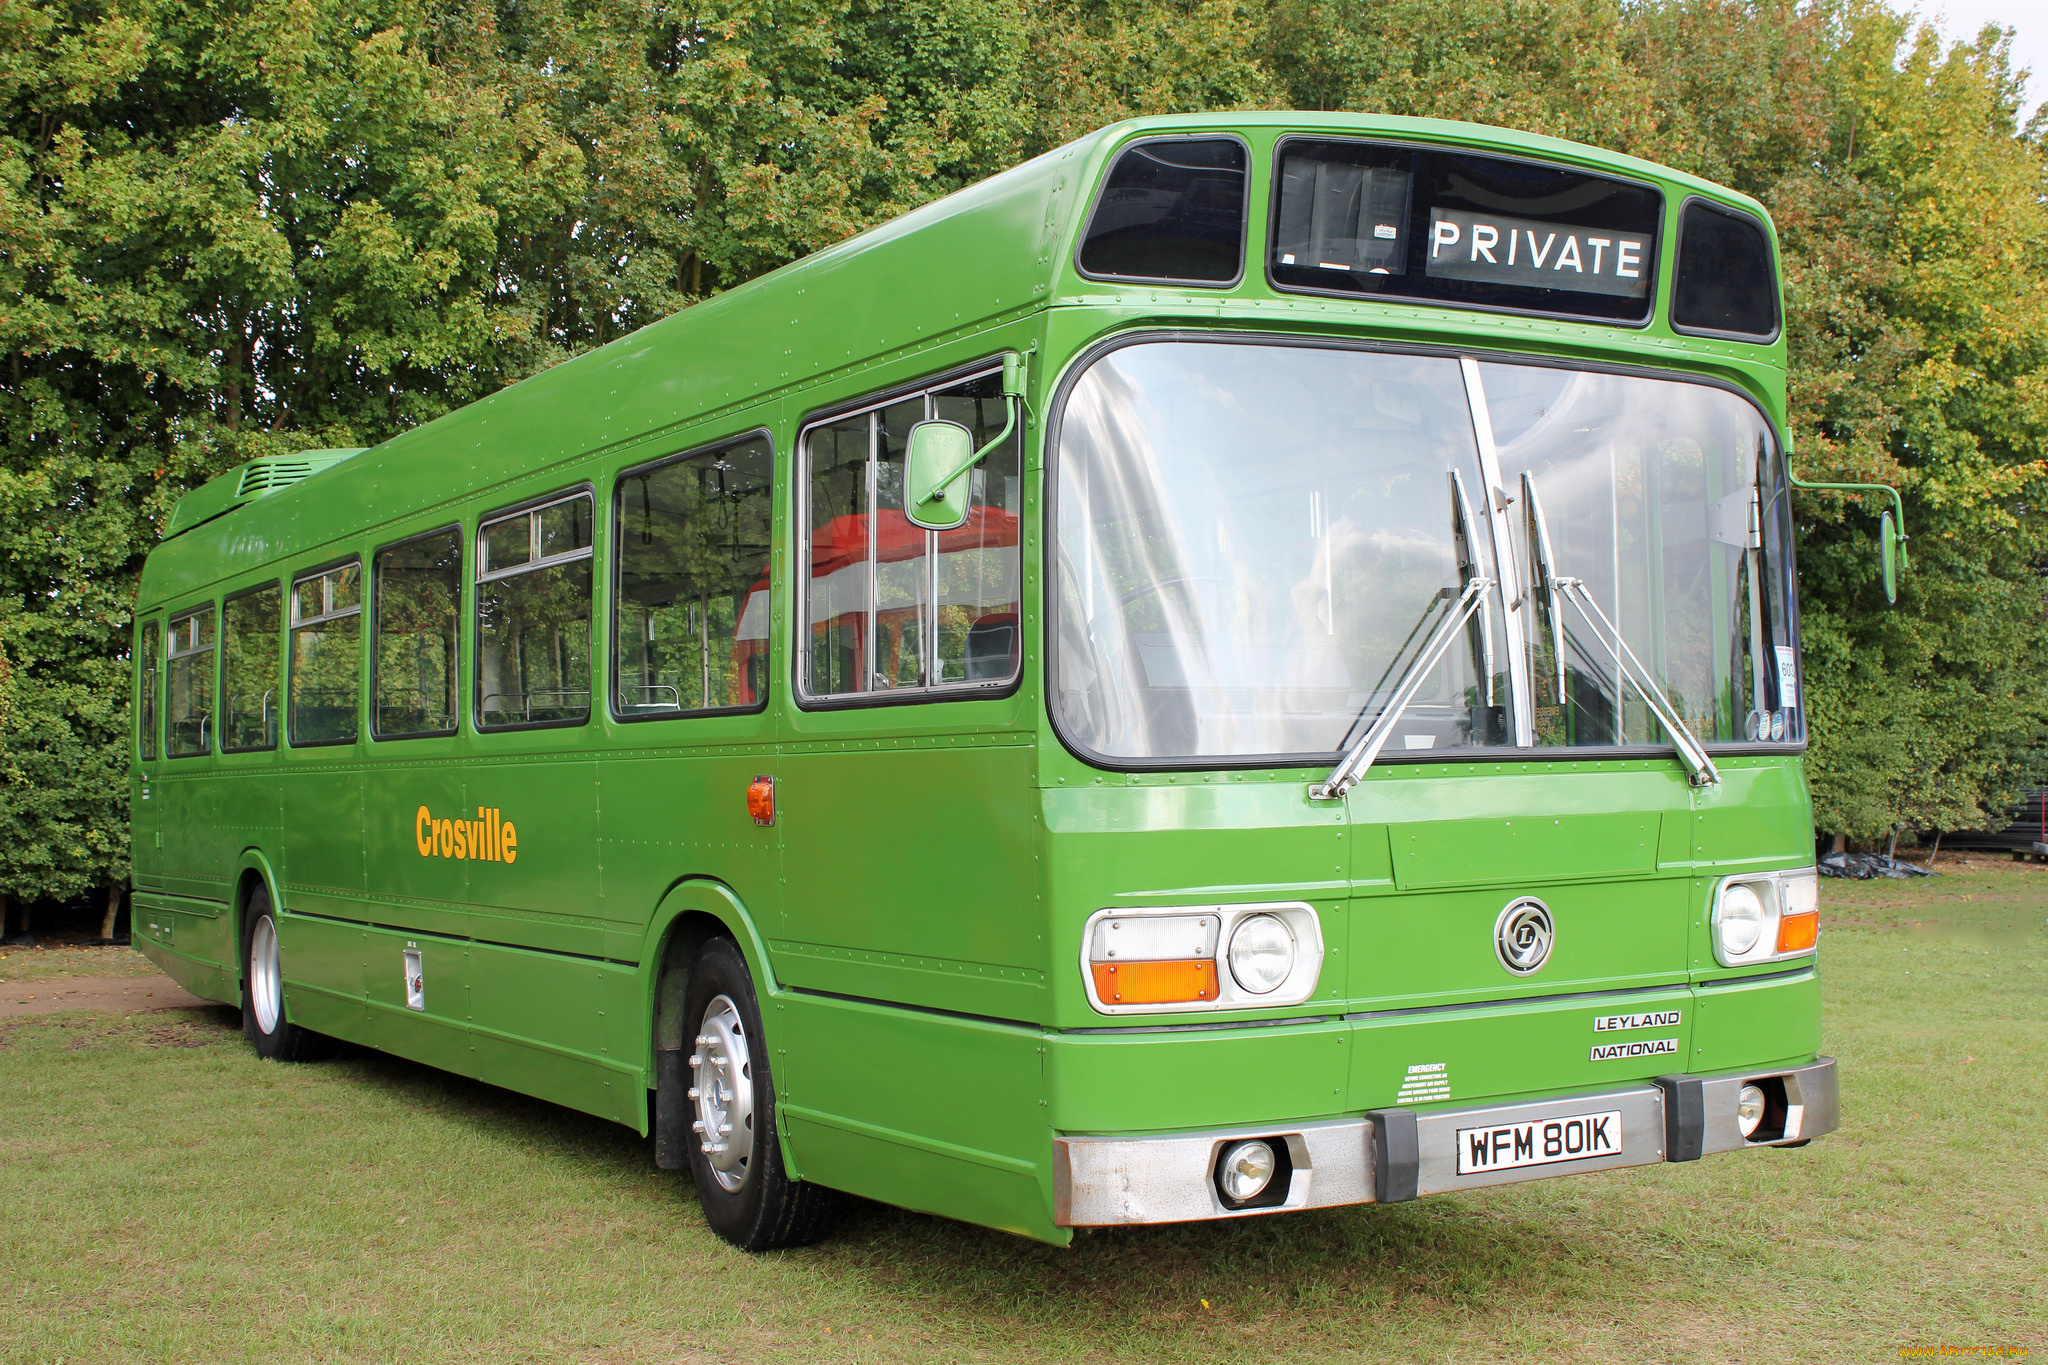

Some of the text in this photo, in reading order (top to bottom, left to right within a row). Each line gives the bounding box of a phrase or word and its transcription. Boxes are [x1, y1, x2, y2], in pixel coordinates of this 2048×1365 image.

[1432, 220, 1642, 279] PRIVATE
[416, 805, 517, 864] Crosville
[1596, 1012, 1680, 1030] LEYLAND
[1592, 1040, 1676, 1059] NATIONAL
[1408, 1063, 1446, 1073] EMERGENCY
[1470, 1116, 1611, 1167] WFM 801K
